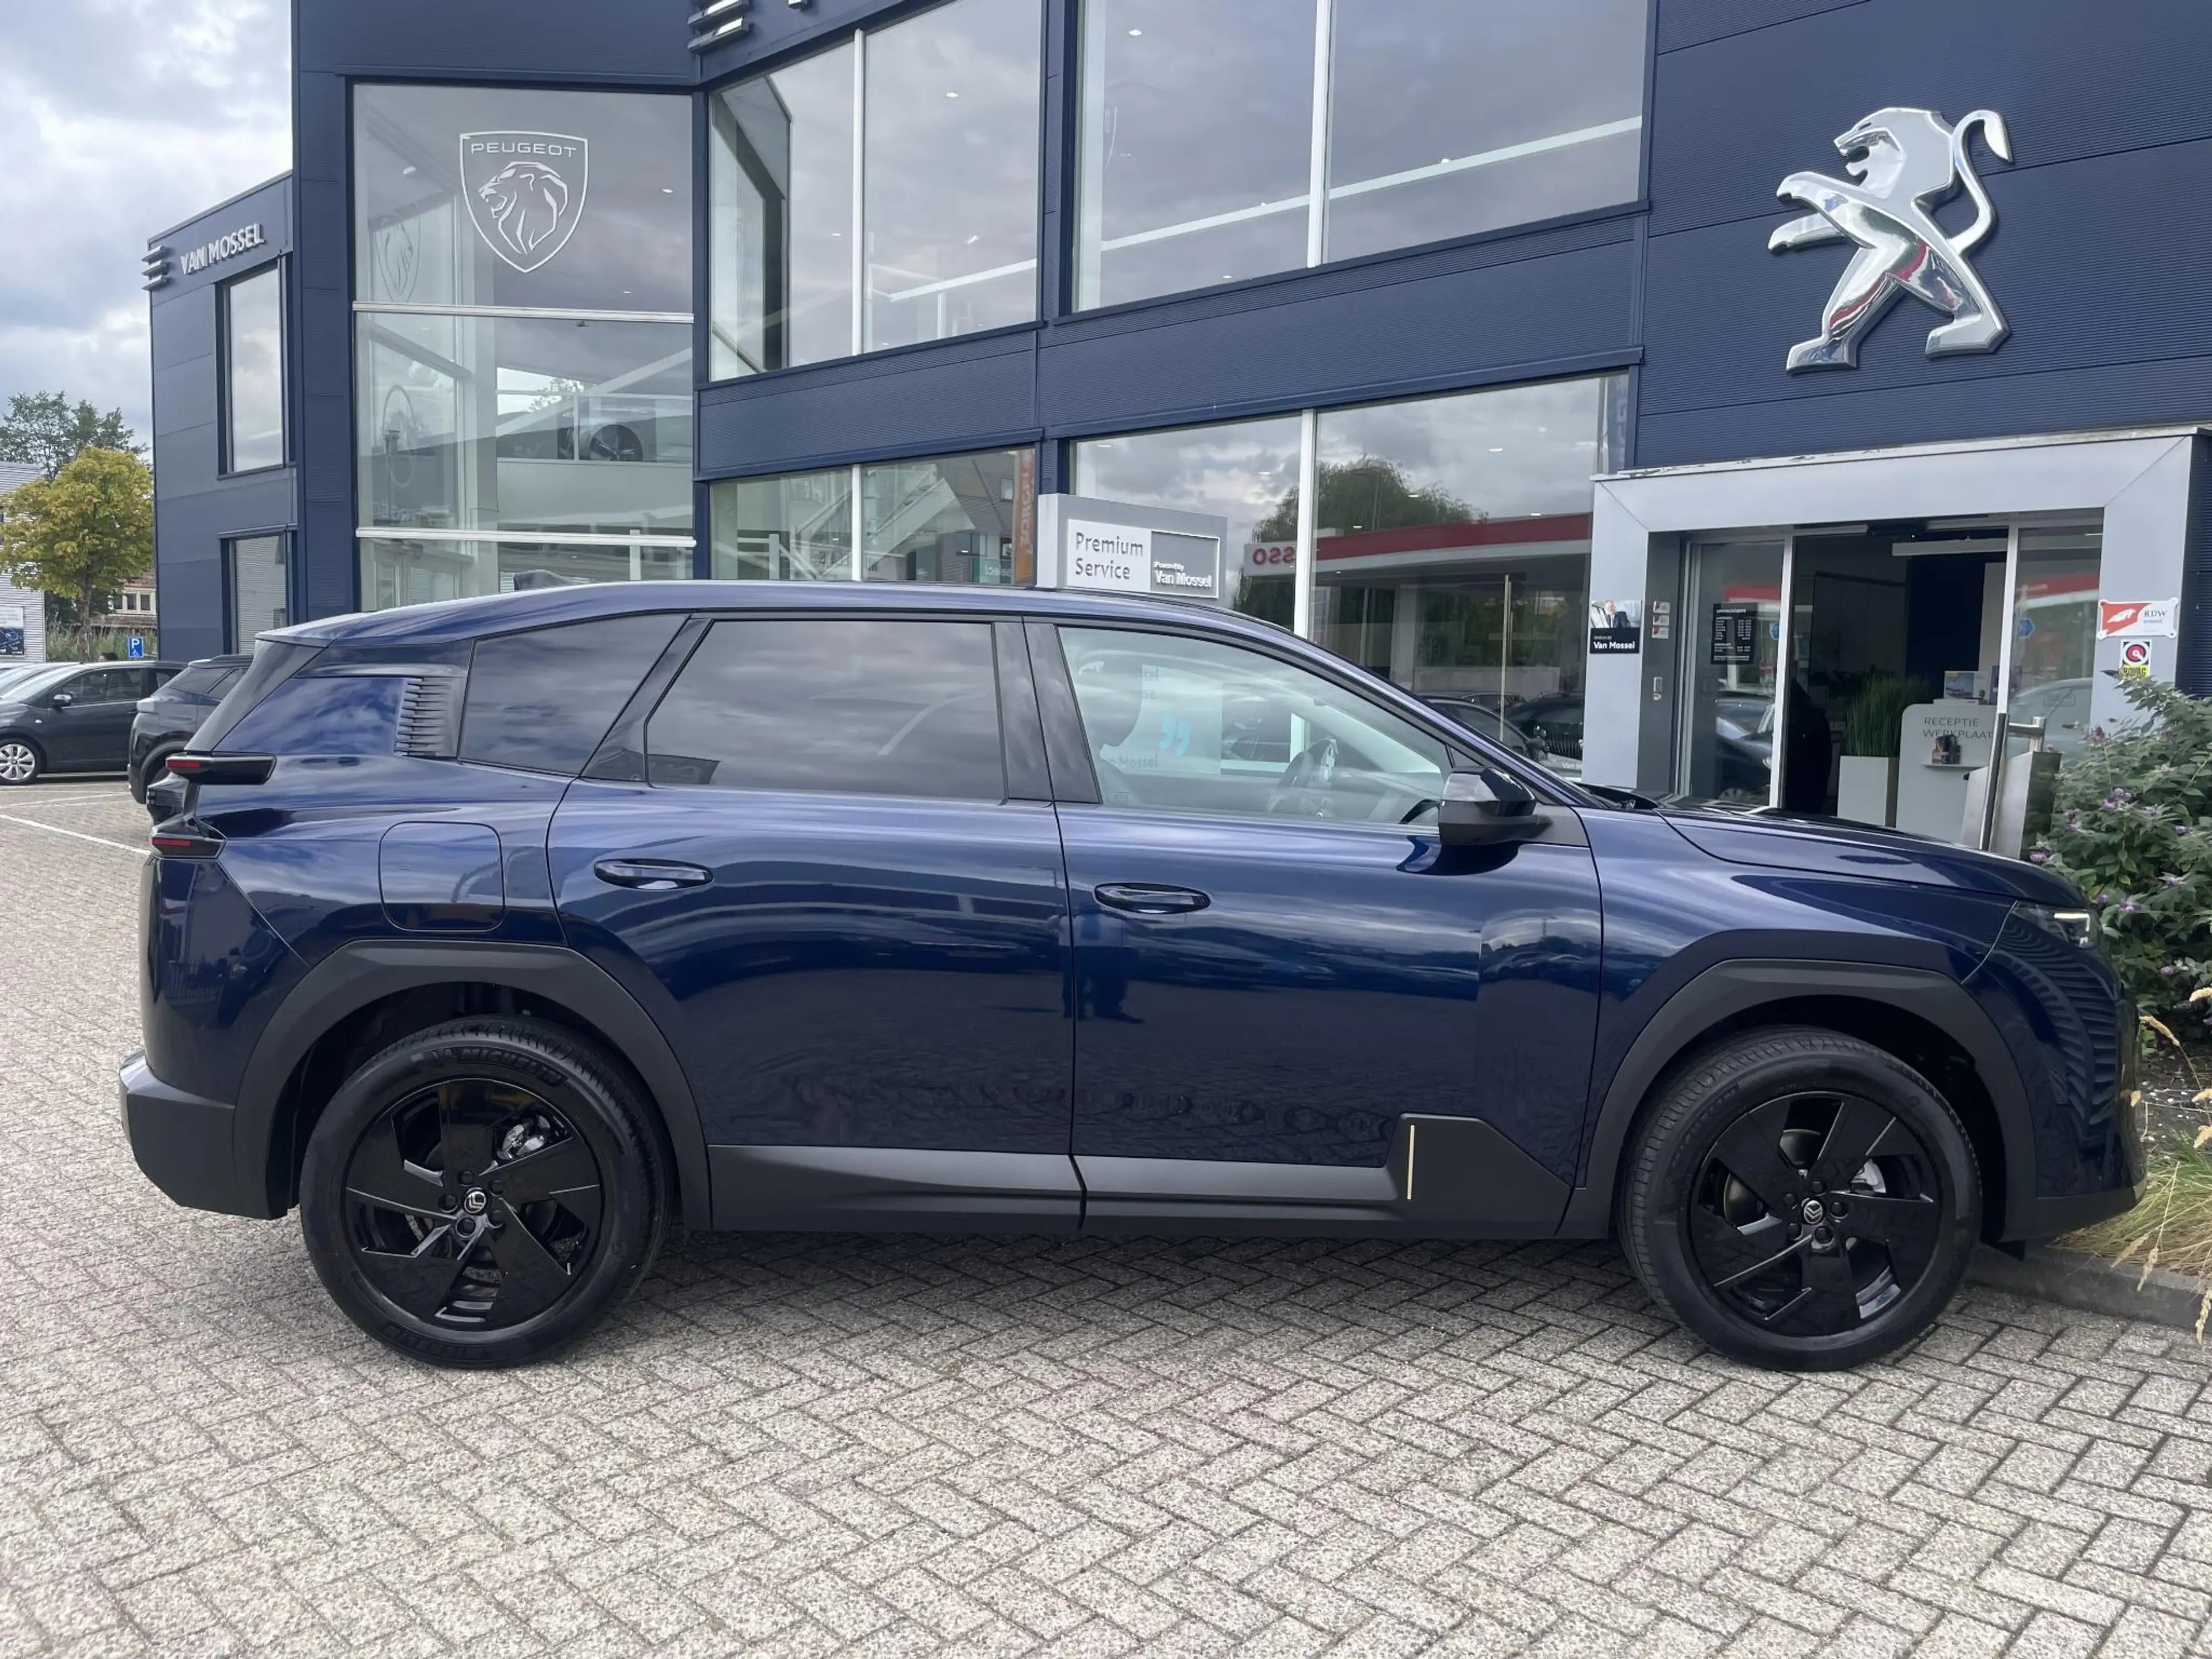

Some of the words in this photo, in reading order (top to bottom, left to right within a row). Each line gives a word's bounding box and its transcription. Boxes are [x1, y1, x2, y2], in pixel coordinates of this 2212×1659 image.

[470, 141, 577, 158] PEUGEOT
[180, 244, 209, 275] VAN
[209, 224, 264, 263] MOSSEL
[1075, 532, 1143, 557] Premium
[1075, 557, 1130, 580] Service
[1154, 570, 1175, 584] Van
[1176, 571, 1213, 588] Mossel
[131, 638, 140, 649] P
[1593, 641, 1607, 649] Van
[1609, 641, 1635, 649] Mossel
[1924, 717, 1980, 727] RECEPTIE
[1923, 729, 1993, 740] WERKPLAAT
